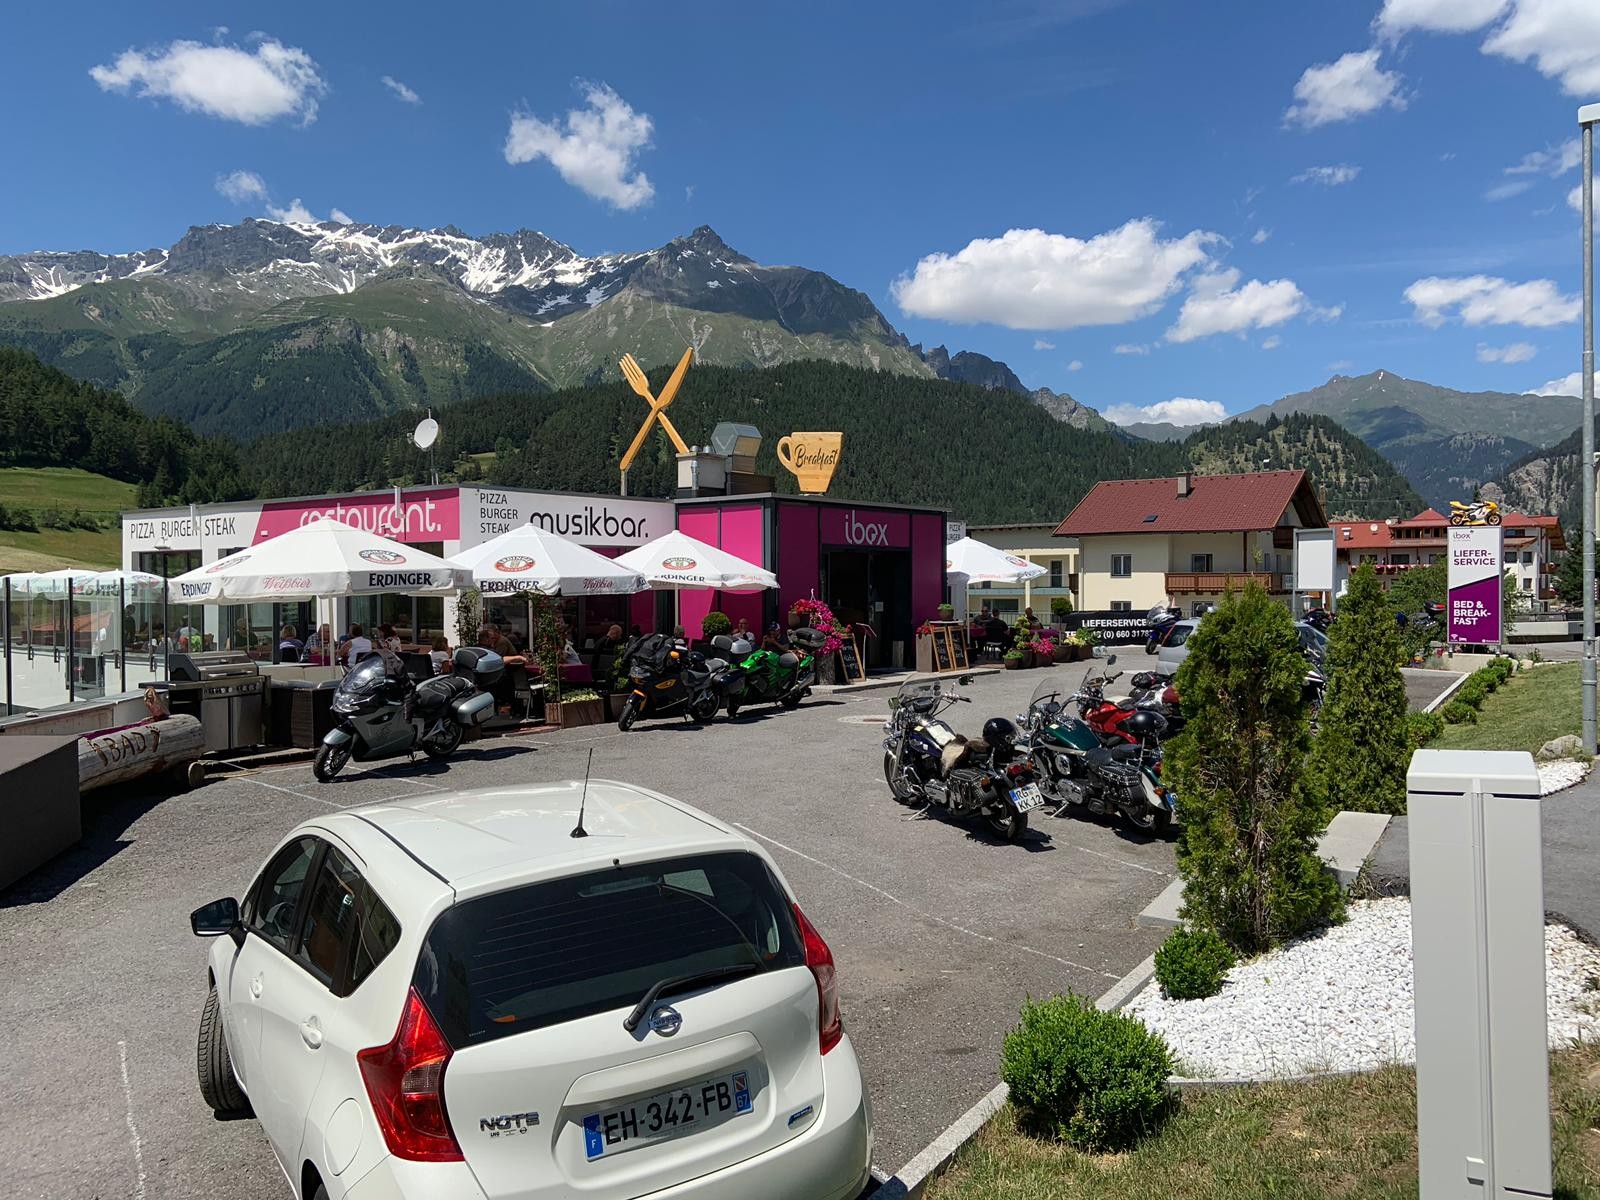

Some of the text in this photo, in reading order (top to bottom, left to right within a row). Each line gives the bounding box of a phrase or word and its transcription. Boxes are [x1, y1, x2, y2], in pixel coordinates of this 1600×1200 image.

[794, 443, 839, 470] Breakfast
[480, 492, 508, 505] PIZZA
[480, 507, 519, 520] BURGER
[130, 522, 155, 539] PIZZA
[204, 517, 236, 536] STEAK
[480, 522, 510, 534] STEAK
[530, 506, 649, 538] musikbar.
[1454, 549, 1491, 557] LIEFER-
[1454, 558, 1496, 566] SERVICE
[369, 572, 433, 588] ERDINGER
[181, 582, 212, 597] ERDINGER
[1453, 601, 1484, 609] BED &
[1453, 609, 1491, 617] BREAK-
[1081, 619, 1147, 628] LIEFERSERVICE
[1453, 617, 1478, 625] FAST
[1103, 630, 1115, 640] (0)
[1016, 787, 1029, 799] RG
[1031, 794, 1043, 806] 12
[737, 1094, 750, 1108] 67
[603, 1081, 732, 1146] EH-342-FB
[480, 1111, 540, 1131] NOTE
[591, 1139, 597, 1149] F
